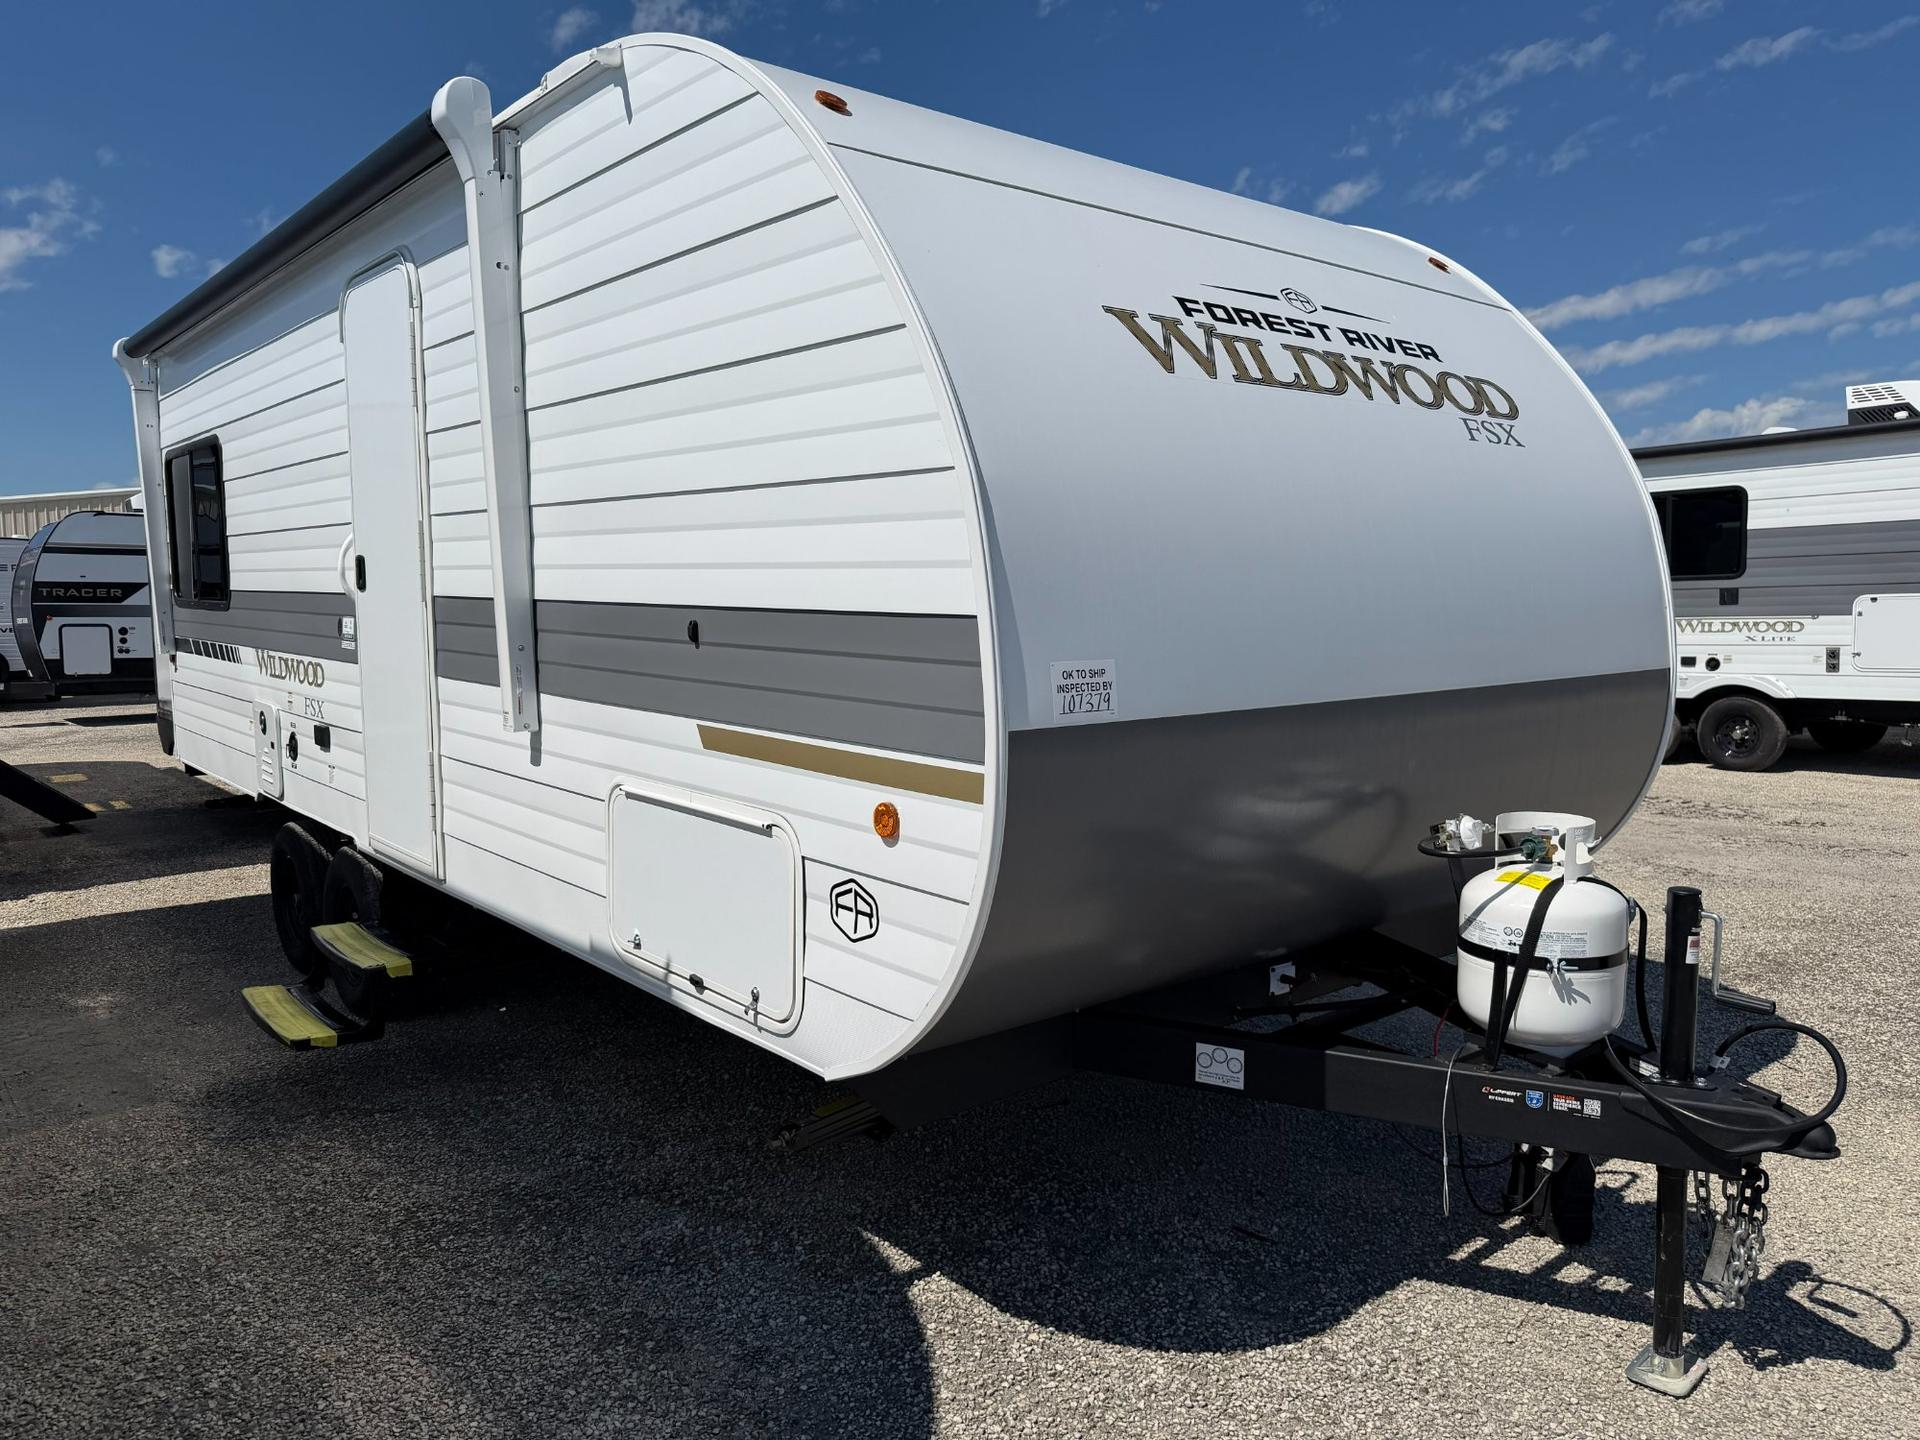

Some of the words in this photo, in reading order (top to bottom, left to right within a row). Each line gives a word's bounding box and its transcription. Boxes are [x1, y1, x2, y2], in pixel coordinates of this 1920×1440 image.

[1172, 295, 1332, 342] FOREST
[1335, 326, 1444, 363] RIVER
[1102, 304, 1520, 421] WILDWOOD
[1458, 416, 1526, 449] FSX
[38, 587, 123, 597] TRACER
[1677, 619, 1805, 633] WILDWOOD
[254, 648, 325, 688] WILDWOOD
[1062, 670, 1074, 680] OK
[1075, 669, 1087, 679] TO
[1088, 668, 1106, 679] SHIP
[1056, 682, 1101, 694] INSPECTED
[1102, 681, 1113, 691] BY
[304, 696, 325, 719] FSX
[1062, 692, 1111, 713] 107379
